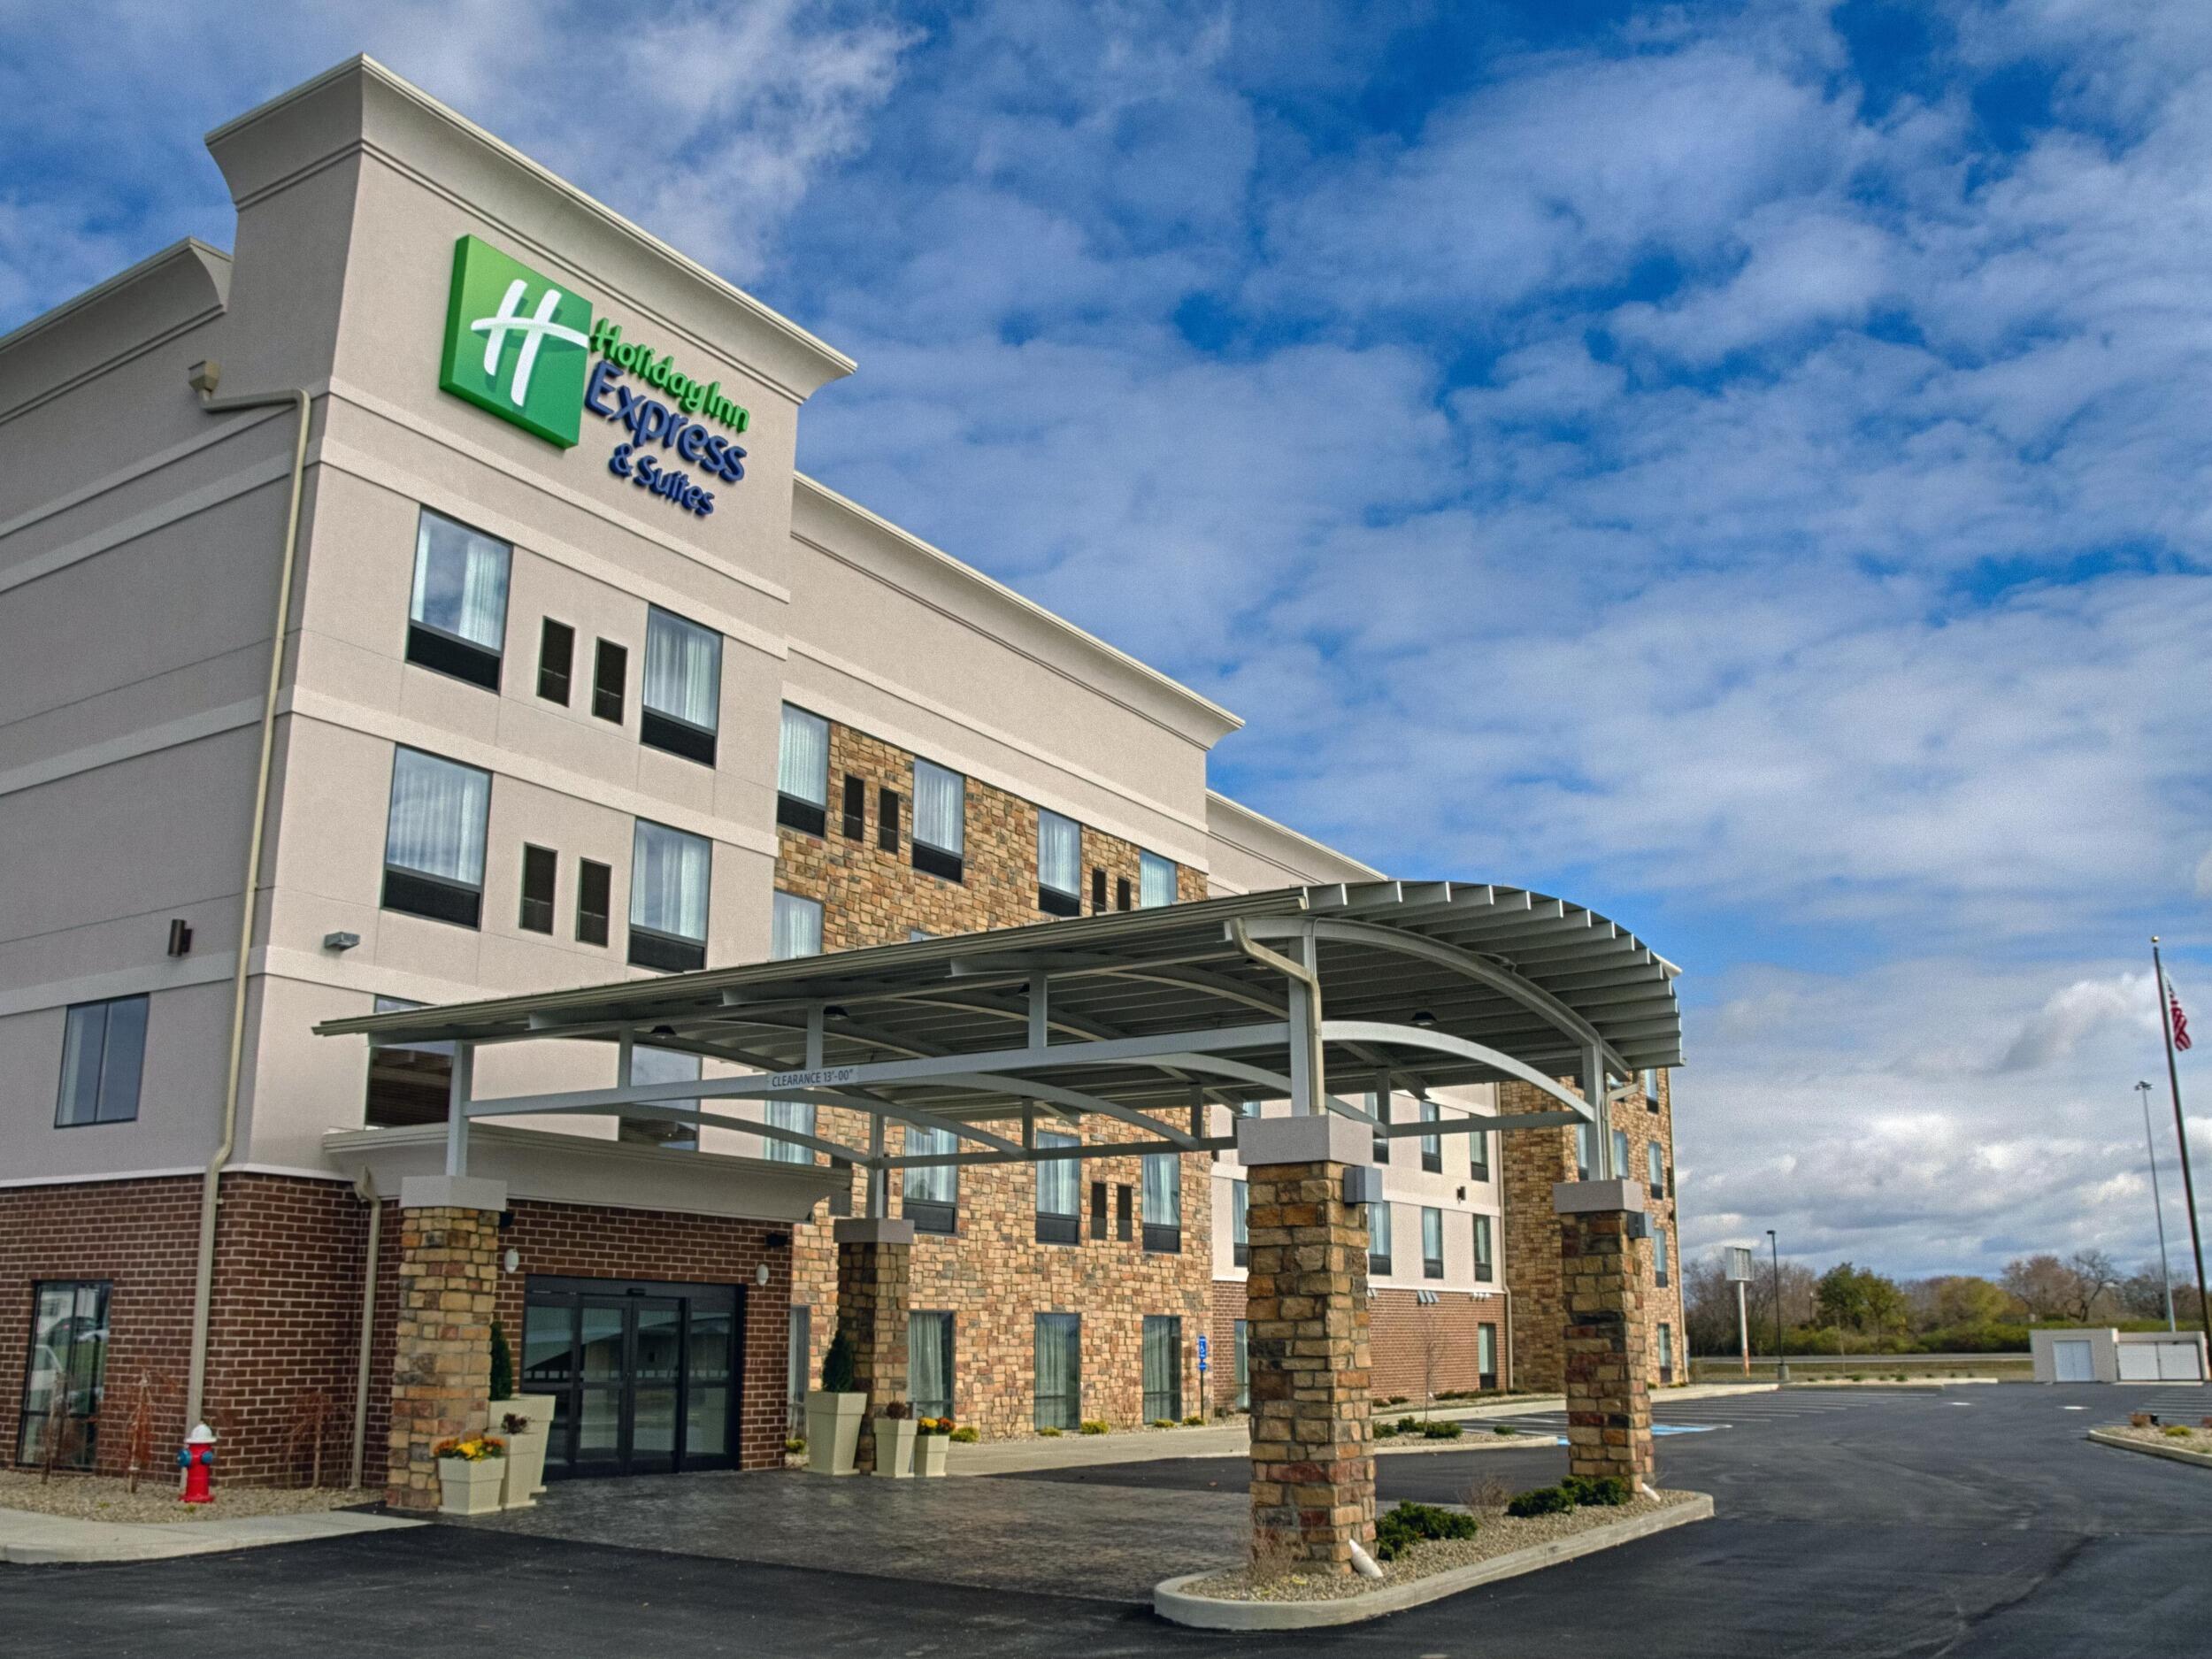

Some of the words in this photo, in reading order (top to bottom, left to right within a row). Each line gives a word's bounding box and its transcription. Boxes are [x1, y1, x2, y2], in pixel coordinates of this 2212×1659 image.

[586, 360, 748, 482] Express
[592, 318, 705, 412] Holiday
[704, 381, 749, 433] Inn
[609, 443, 634, 478] &
[634, 455, 715, 516] Suites
[772, 1071, 821, 1087] CLEARANCE
